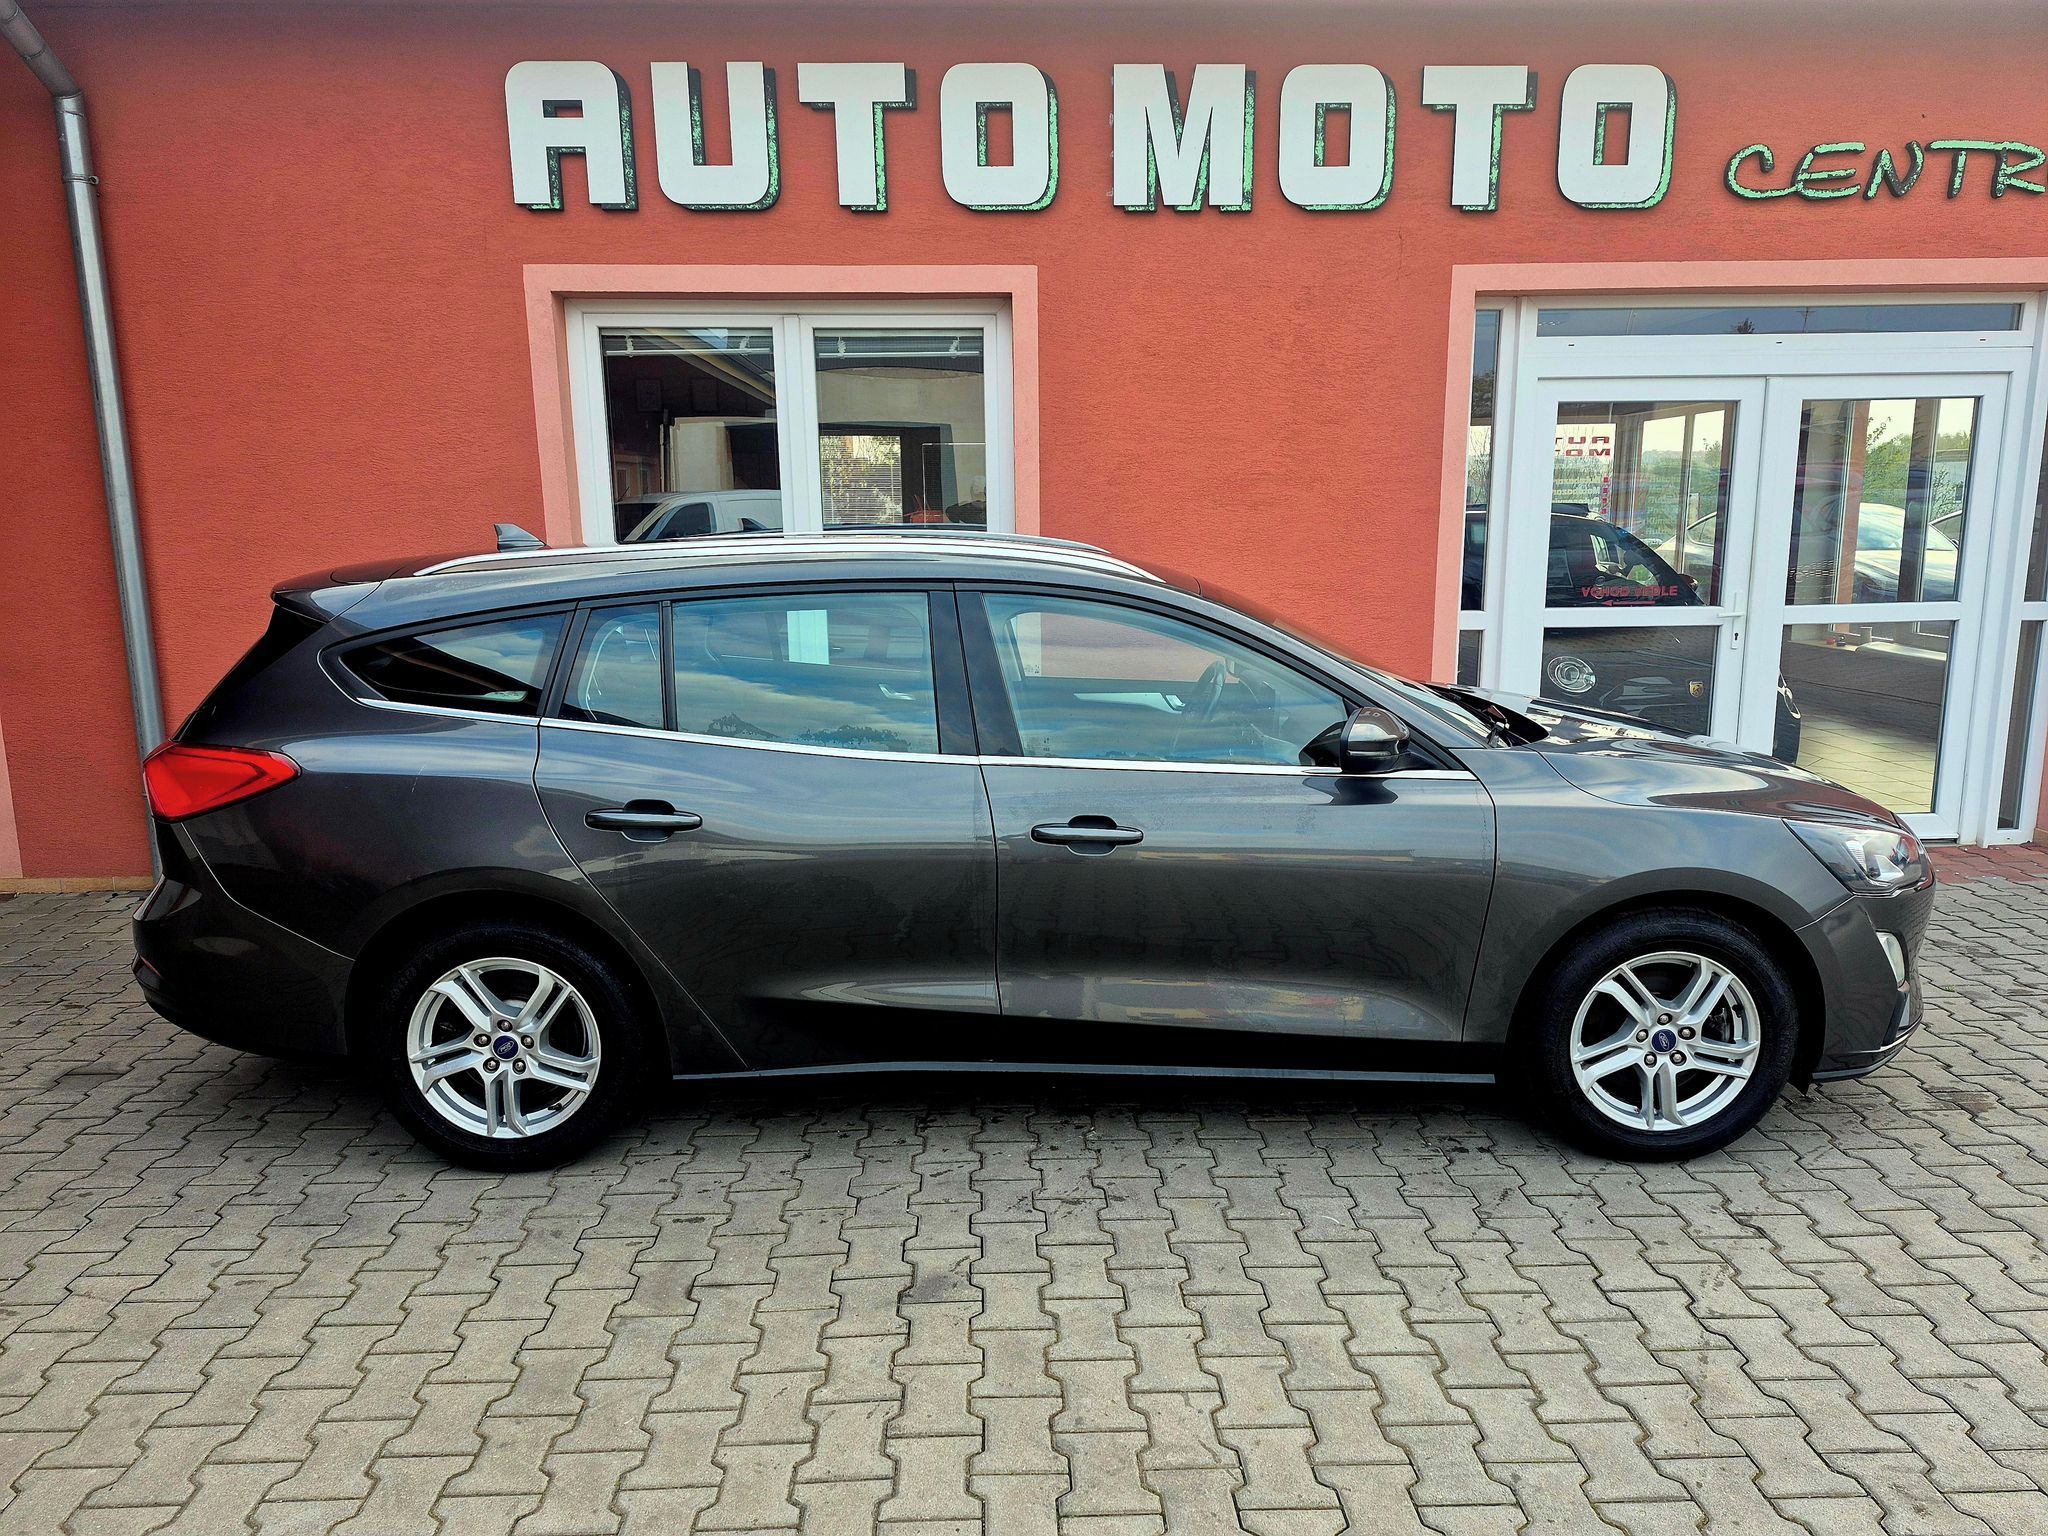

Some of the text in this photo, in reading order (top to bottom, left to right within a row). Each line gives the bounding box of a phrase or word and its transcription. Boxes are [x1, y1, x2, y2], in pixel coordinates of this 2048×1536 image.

[504, 60, 2048, 211] AUTO MOTO CENTR
[1634, 586, 1678, 597] VEDLE
